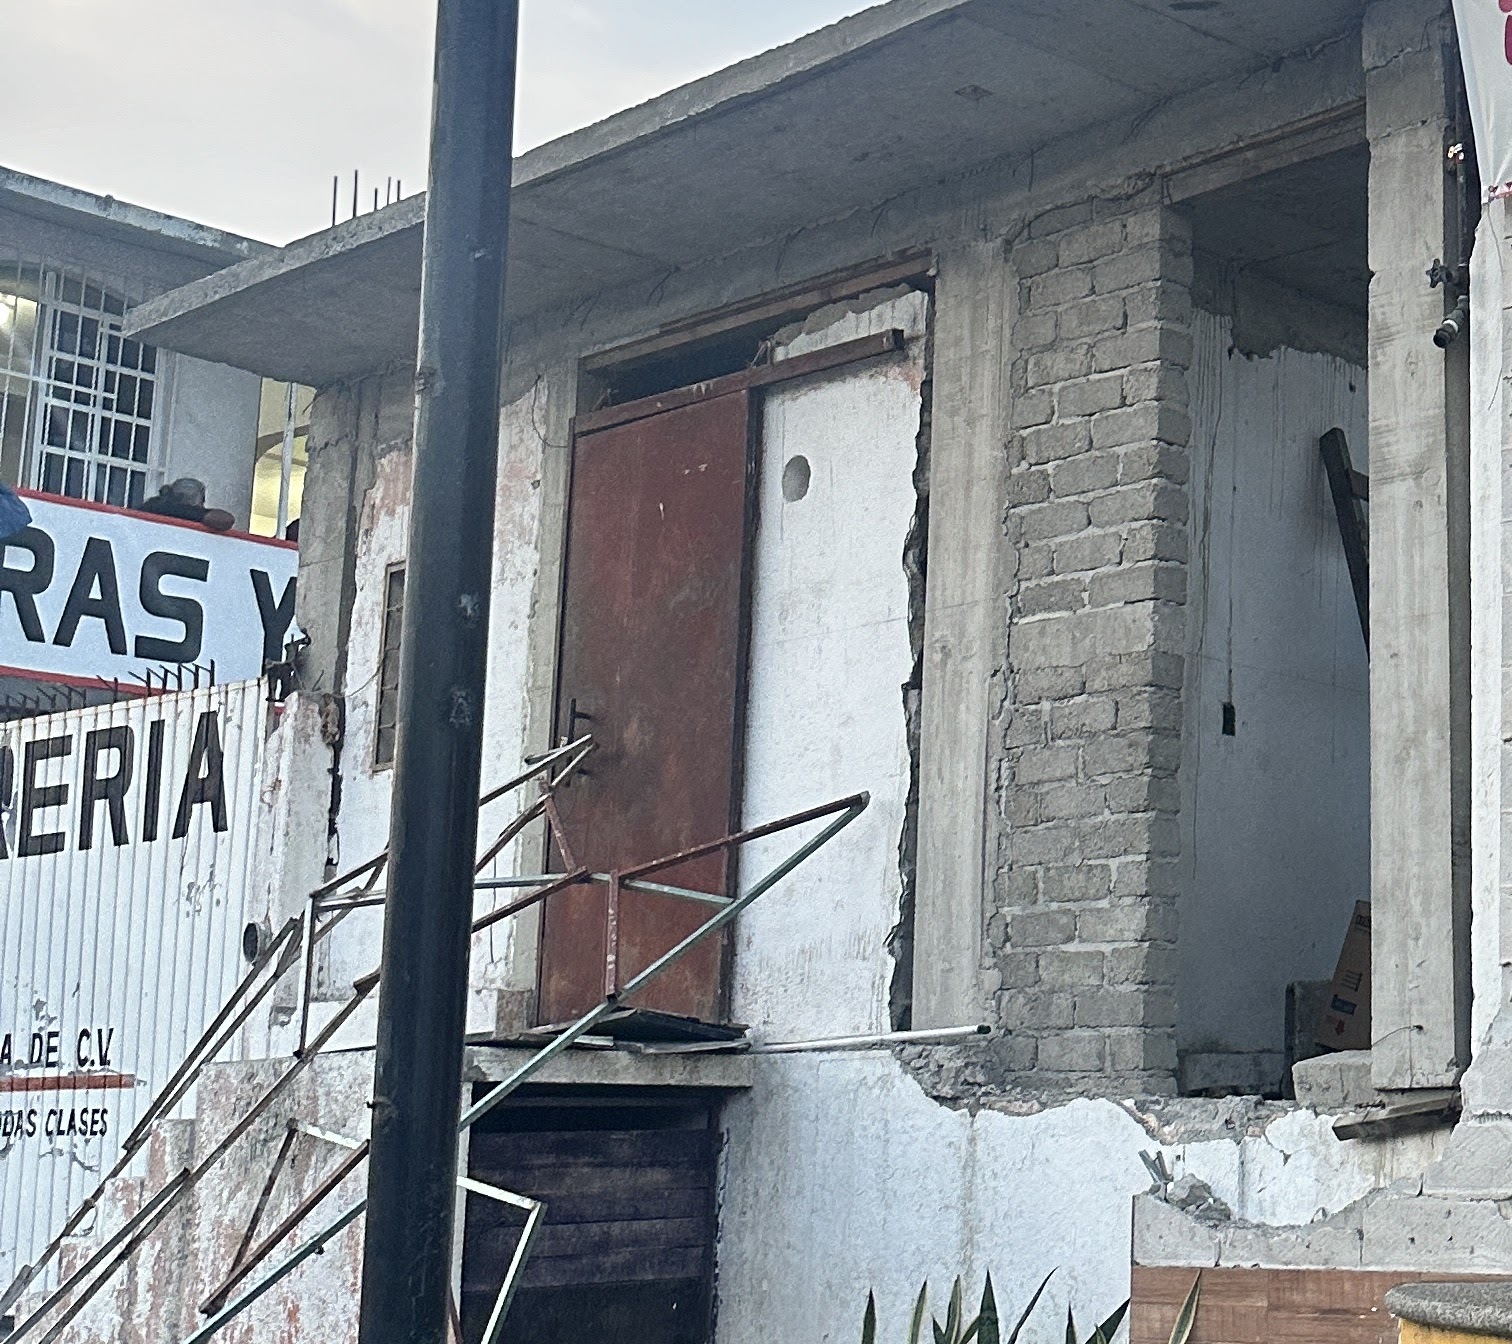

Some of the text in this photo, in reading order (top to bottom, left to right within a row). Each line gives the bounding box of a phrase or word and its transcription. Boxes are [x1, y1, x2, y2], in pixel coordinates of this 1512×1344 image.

[0, 526, 210, 664] RAS
[30, 1031, 60, 1068] DE
[0, 1107, 109, 1138] DAS CLASES
